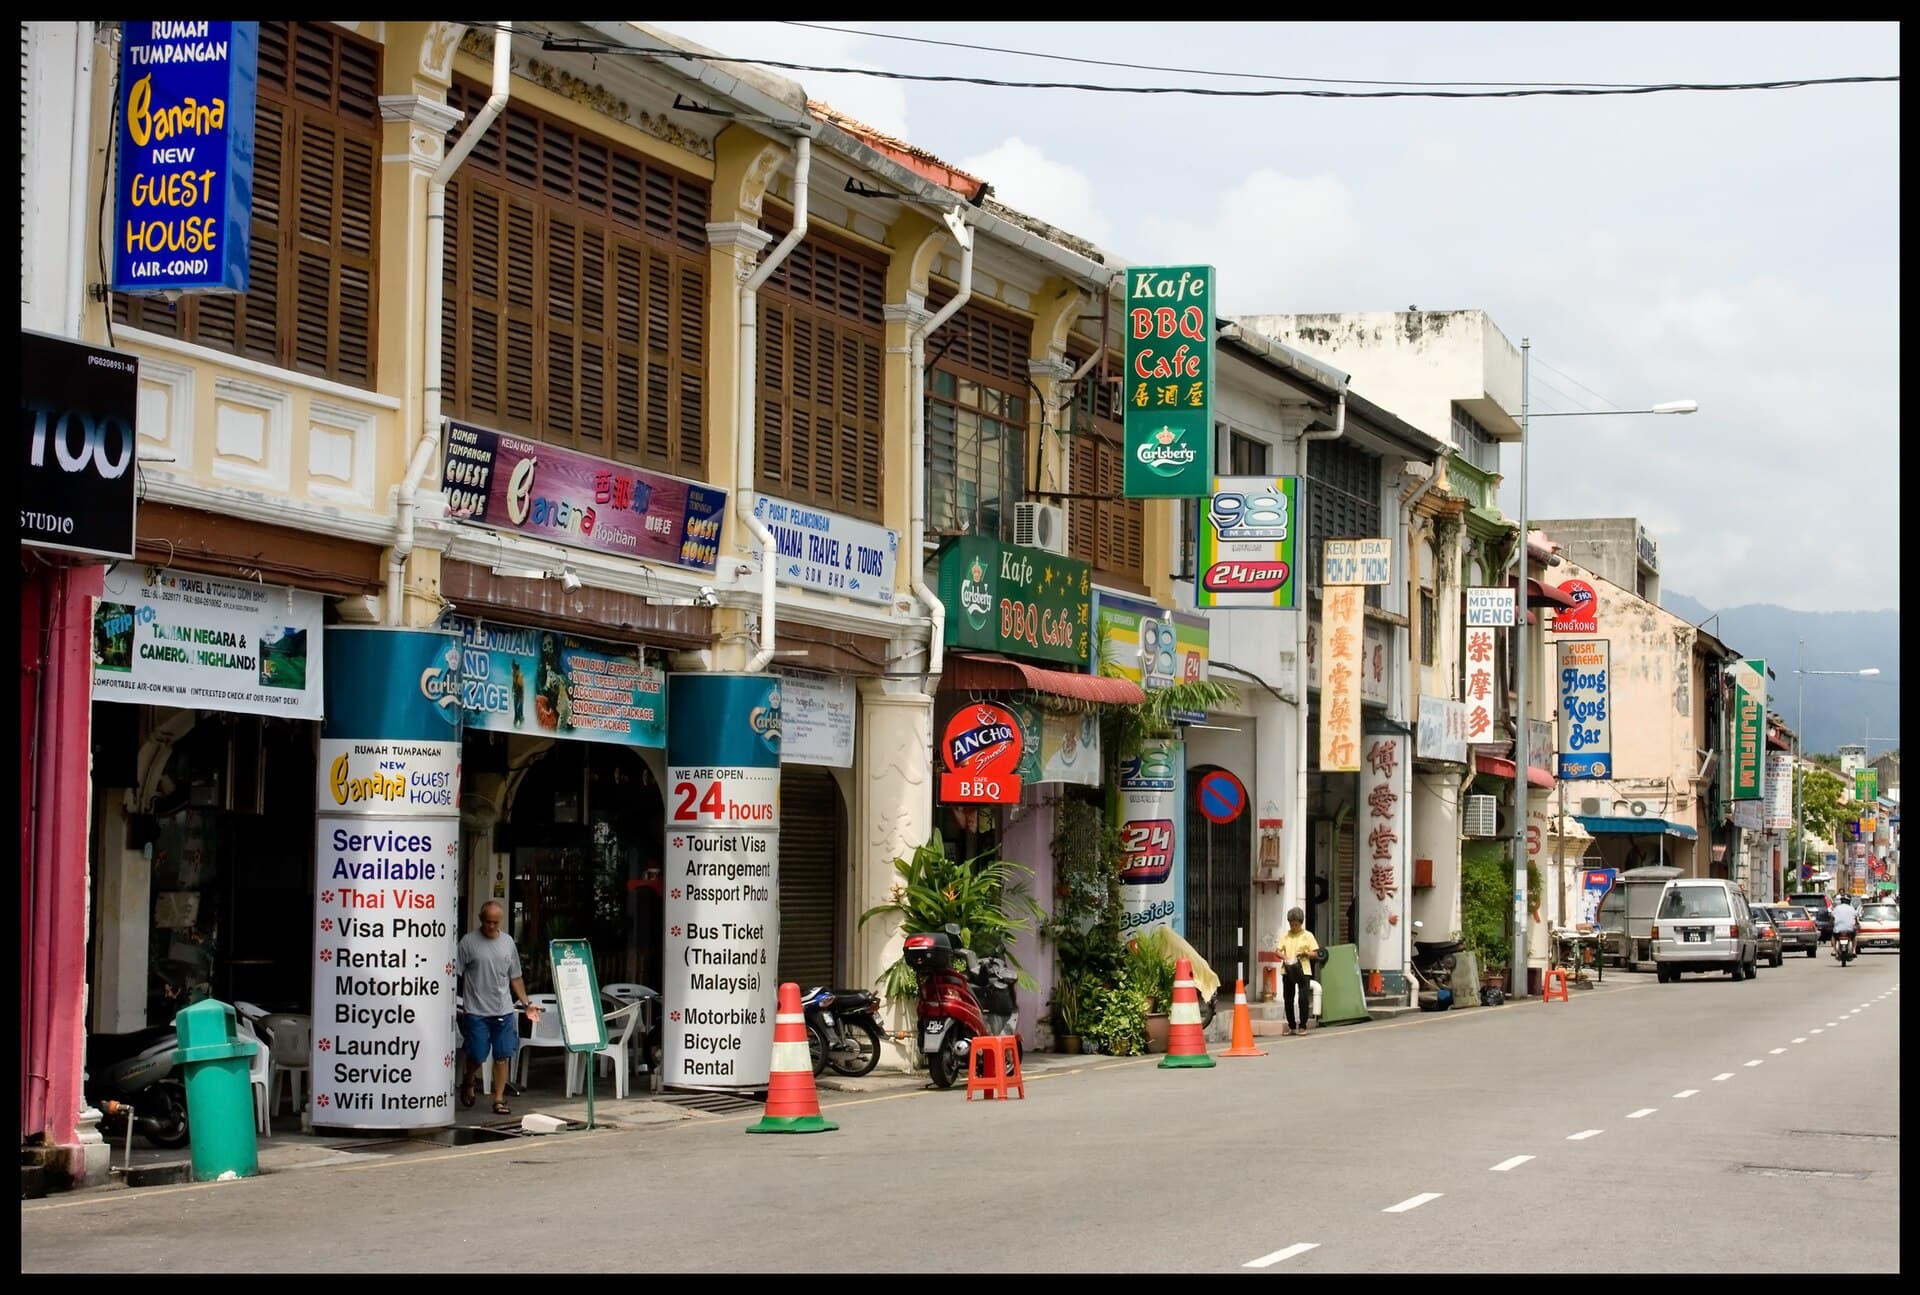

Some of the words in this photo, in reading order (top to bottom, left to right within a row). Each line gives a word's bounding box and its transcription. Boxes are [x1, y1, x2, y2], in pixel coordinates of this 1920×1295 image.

[151, 21, 208, 39] RUMAH
[130, 41, 227, 65] TUMPANGAN
[127, 72, 225, 146] Banana
[152, 148, 195, 164] NEW
[131, 169, 216, 207] GUEST
[126, 216, 216, 253] HOUSE
[131, 260, 208, 278] (AIR-COND)
[1132, 271, 1204, 301] Kafe
[1130, 306, 1205, 341] BBQ
[1135, 344, 1200, 379] Cafe
[1131, 381, 1204, 407] 居酒屋
[501, 437, 519, 453] KEDAI
[520, 440, 534, 454] KOPI
[1137, 443, 1196, 463] Carlsberg
[446, 459, 489, 489] GUEST
[442, 484, 485, 516] HOUSE
[507, 456, 597, 537] Banana
[1210, 487, 1288, 528] 98
[768, 503, 788, 522] PUSAT
[594, 523, 637, 547] Kopitiam
[687, 516, 719, 541] GUEST
[681, 541, 717, 565] HOUSE
[809, 534, 840, 567] TRAVEL
[845, 544, 851, 570] &
[858, 546, 883, 577] TOURS
[805, 566, 821, 583] SDN
[1000, 551, 1033, 587] Kafe
[1212, 565, 1248, 585] 24
[1248, 568, 1284, 583] jam
[961, 579, 992, 608] Carlsberg
[1469, 597, 1512, 607] MOTOR
[104, 613, 133, 638] TRIP
[1000, 598, 1038, 648] BBQ
[1042, 608, 1073, 649] Cafe
[1469, 609, 1512, 624] WENG
[1554, 622, 1573, 631] HONG
[1574, 622, 1595, 631] KONG
[194, 626, 237, 648] NEGARA
[238, 634, 247, 649] &
[1140, 612, 1176, 676] 98
[1569, 643, 1596, 654] PUSAT
[140, 644, 194, 665] CAMERO
[197, 650, 256, 671] HIGHLANDS
[1186, 657, 1199, 677] 24
[93, 678, 136, 690] COMFORTABLE
[137, 682, 161, 693] AIR-CON
[162, 684, 175, 694] MINI
[175, 686, 187, 695] VAN
[227, 691, 245, 700] CHECK
[246, 693, 252, 701] AT
[253, 694, 264, 702] OUR
[265, 695, 282, 704] FRONT
[1562, 668, 1606, 695] Hong
[462, 681, 509, 713] KAGE
[621, 705, 654, 721] PACKAGE
[1563, 696, 1606, 723] Kong
[572, 715, 597, 729] DIVING
[598, 718, 631, 733] PACKAGE
[1569, 723, 1601, 751] Bar
[1739, 694, 1757, 787] FUJIFILM
[354, 745, 388, 755] RUMAH
[392, 746, 442, 757] TUMPANGAN
[379, 761, 406, 770] NEW
[675, 770, 690, 780] WE
[693, 769, 714, 779] ARE
[1561, 761, 1588, 776] Tiger
[330, 752, 406, 805] Banana
[411, 771, 451, 788] GUEST
[410, 790, 451, 805] HOUSE
[673, 781, 725, 821] 24
[729, 800, 773, 820] hours
[960, 782, 1000, 800] BBQ
[333, 829, 432, 852] Services
[686, 835, 737, 852] Tourist
[741, 836, 766, 853] Visa
[1125, 828, 1170, 852] 24
[332, 858, 435, 880] Available
[686, 859, 770, 880] Arrangement
[1123, 854, 1165, 871] jam
[337, 888, 385, 909] Thai
[392, 889, 435, 909] Visa
[686, 884, 740, 905] Passport
[743, 885, 768, 902] Photo
[1119, 900, 1175, 931] Beside
[337, 917, 384, 938] Visa
[392, 918, 446, 938] Photo
[687, 923, 719, 939] Bus
[722, 923, 764, 940] Ticket
[336, 948, 406, 968] Rental
[684, 946, 758, 966] (Thailand
[761, 951, 766, 964] &
[335, 976, 440, 996] Motorbike
[691, 972, 761, 994] Malaysia)
[335, 1003, 416, 1029] Bicycle
[684, 1008, 757, 1025] Motorbike
[760, 1008, 766, 1024] &
[335, 1035, 420, 1060] Laundry
[684, 1033, 741, 1054] Bicycle
[334, 1063, 412, 1083] Service
[684, 1059, 734, 1075] Rental
[334, 1092, 374, 1110] Wifi
[381, 1092, 448, 1110] Internet
